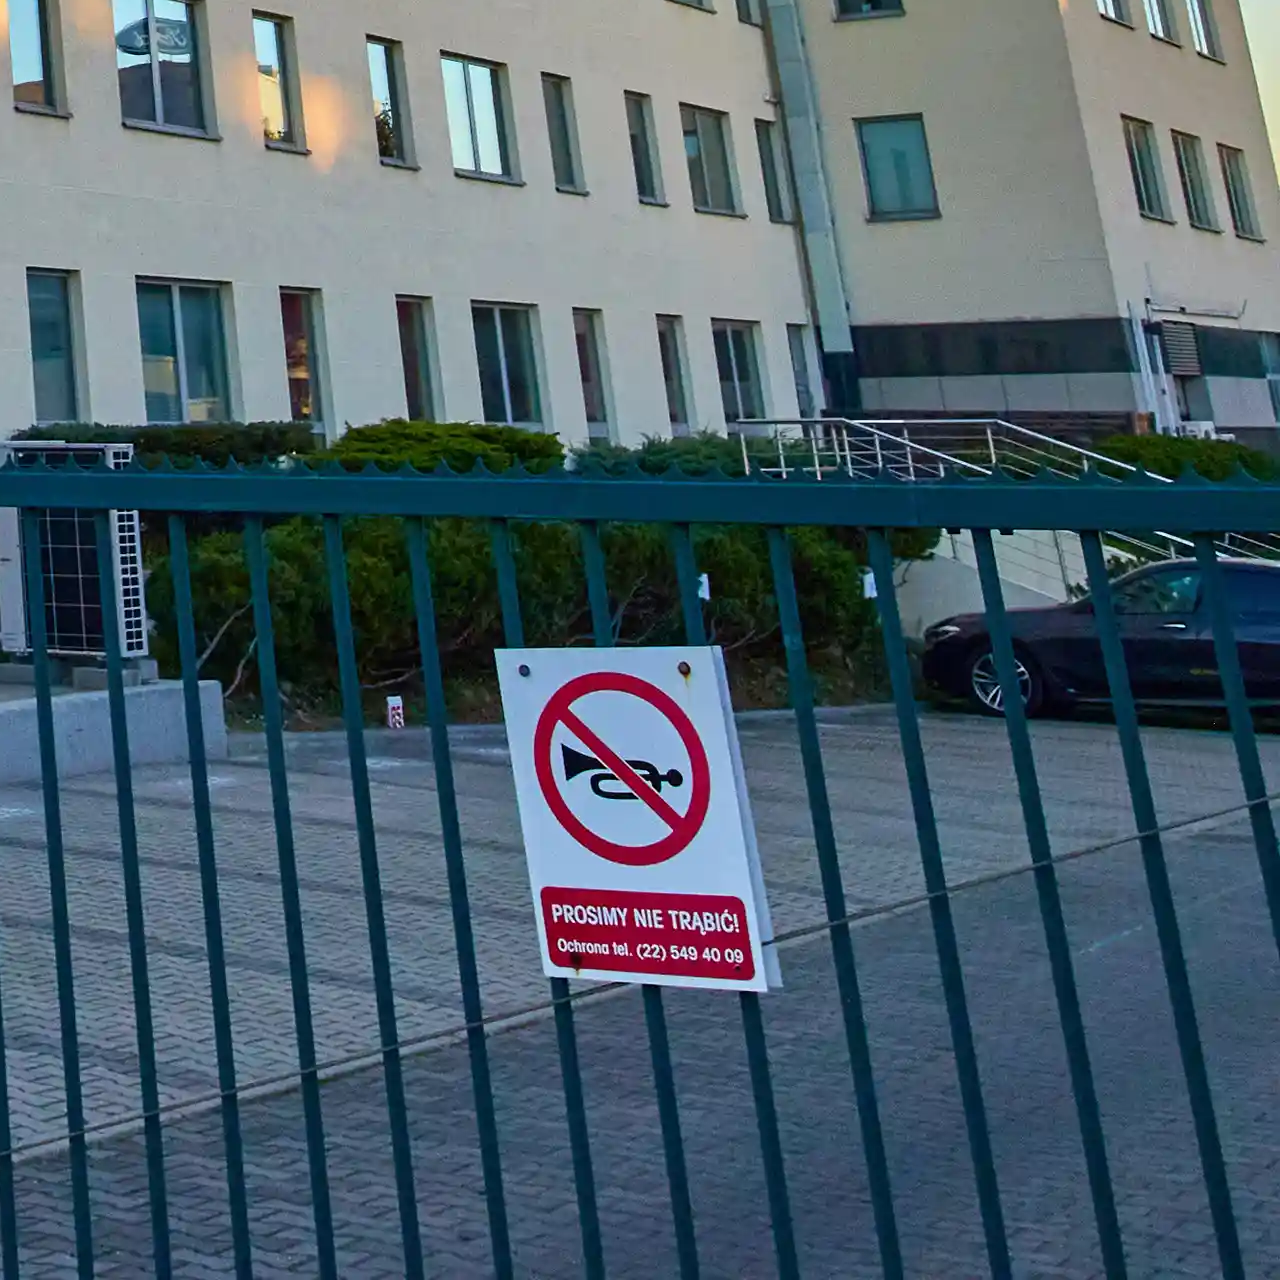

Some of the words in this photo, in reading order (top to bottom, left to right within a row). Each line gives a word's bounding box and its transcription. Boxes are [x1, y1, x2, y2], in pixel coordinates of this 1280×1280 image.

[551, 903, 628, 927] PROSIMY
[633, 908, 665, 929] NIE
[667, 908, 740, 936] TRĄBIĆ!
[557, 938, 609, 955] Ochrona
[612, 941, 633, 956] tel.
[636, 943, 667, 961] (22)
[670, 945, 698, 961] 549
[702, 947, 721, 962] 40
[724, 948, 744, 963] 09
